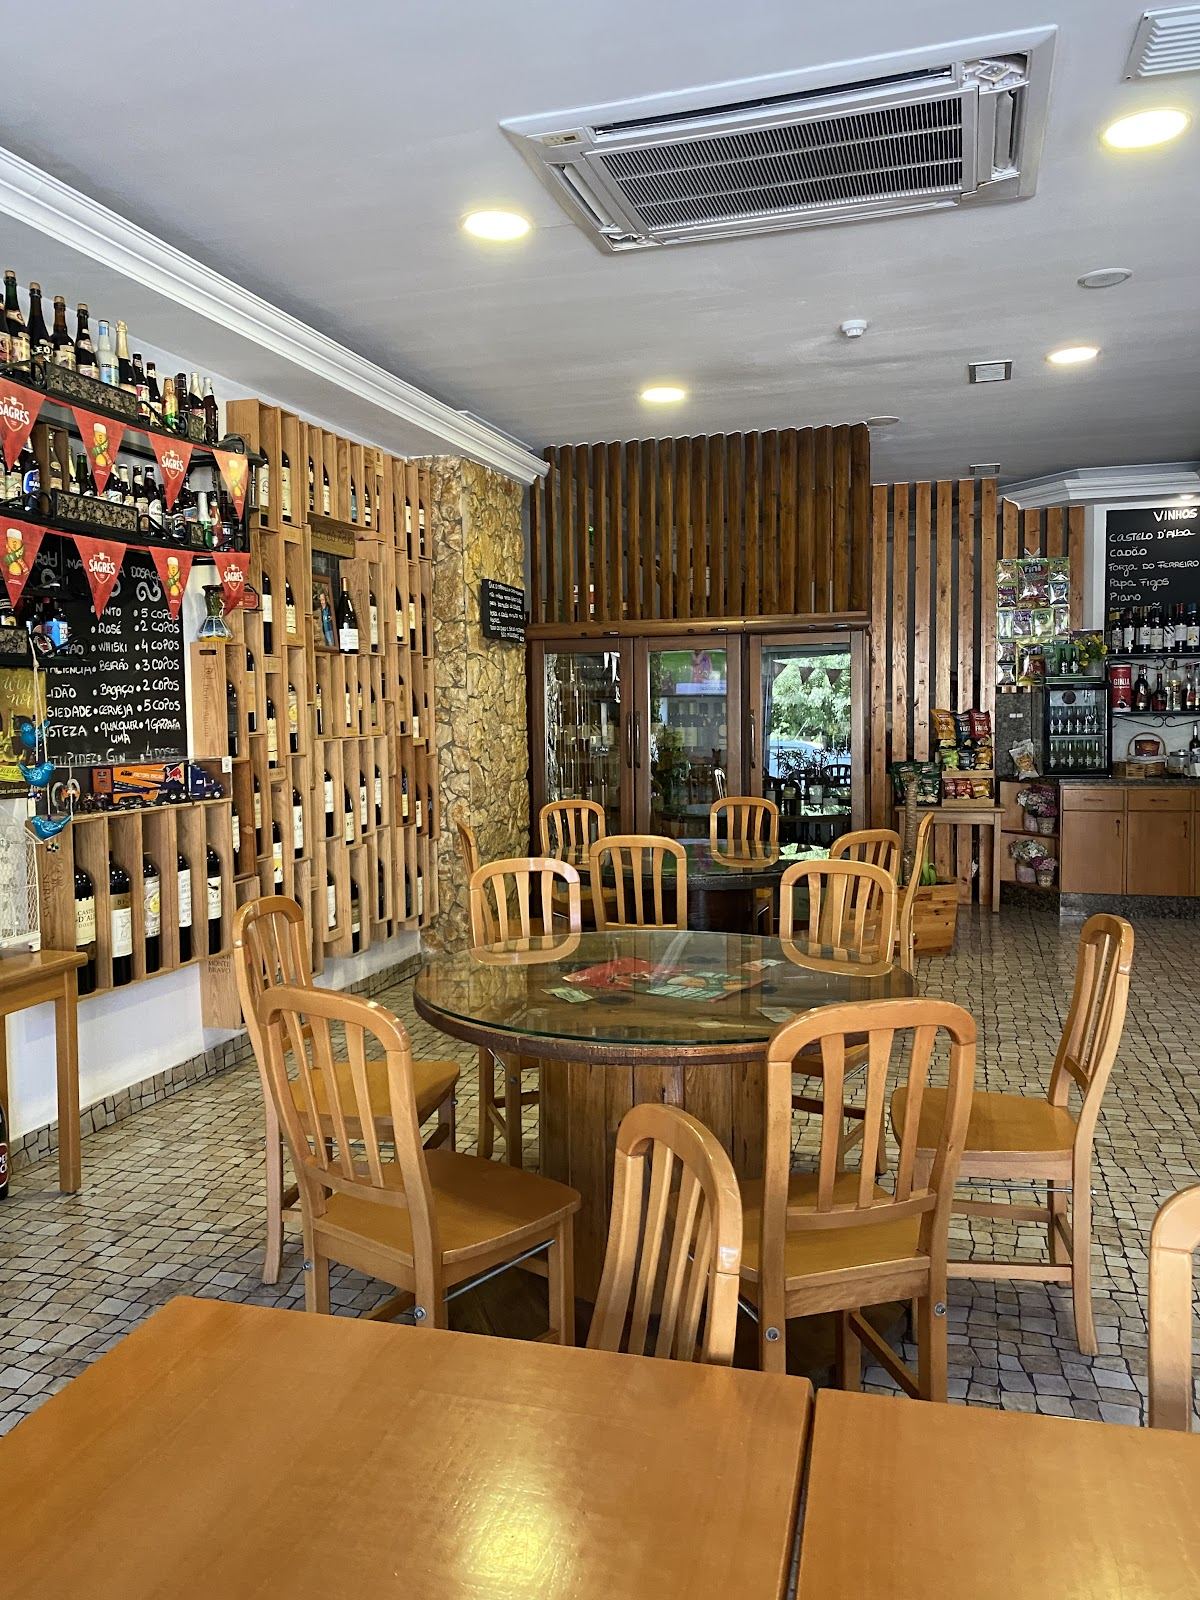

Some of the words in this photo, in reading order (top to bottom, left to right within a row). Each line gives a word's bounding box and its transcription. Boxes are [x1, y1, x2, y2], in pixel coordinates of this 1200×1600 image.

[0, 403, 30, 425] SAGRES
[161, 456, 184, 472] SAGRES
[1153, 508, 1198, 522] VINHOS
[1109, 532, 1153, 542] CASTELO
[89, 558, 116, 576] SAGRES
[224, 571, 244, 582] SAGRES
[141, 608, 149, 618] 5
[98, 621, 122, 634] ROSÉ
[140, 620, 148, 632] 2
[151, 621, 180, 634] COPOS
[98, 642, 128, 653] WHISKI
[141, 638, 149, 653] 4
[151, 639, 180, 651] COPOS
[99, 658, 128, 671] BEIRÃO
[142, 659, 150, 671] 3
[152, 656, 179, 670] COPOS
[142, 679, 150, 691] 2
[152, 677, 179, 691] COPOS
[99, 704, 133, 718] CERVEJA
[144, 699, 151, 711] 5
[152, 698, 181, 711] COPOS
[47, 705, 92, 718] SIEDADE
[145, 718, 151, 731] 1
[47, 725, 87, 738] STEZA
[111, 733, 131, 745] UMA
